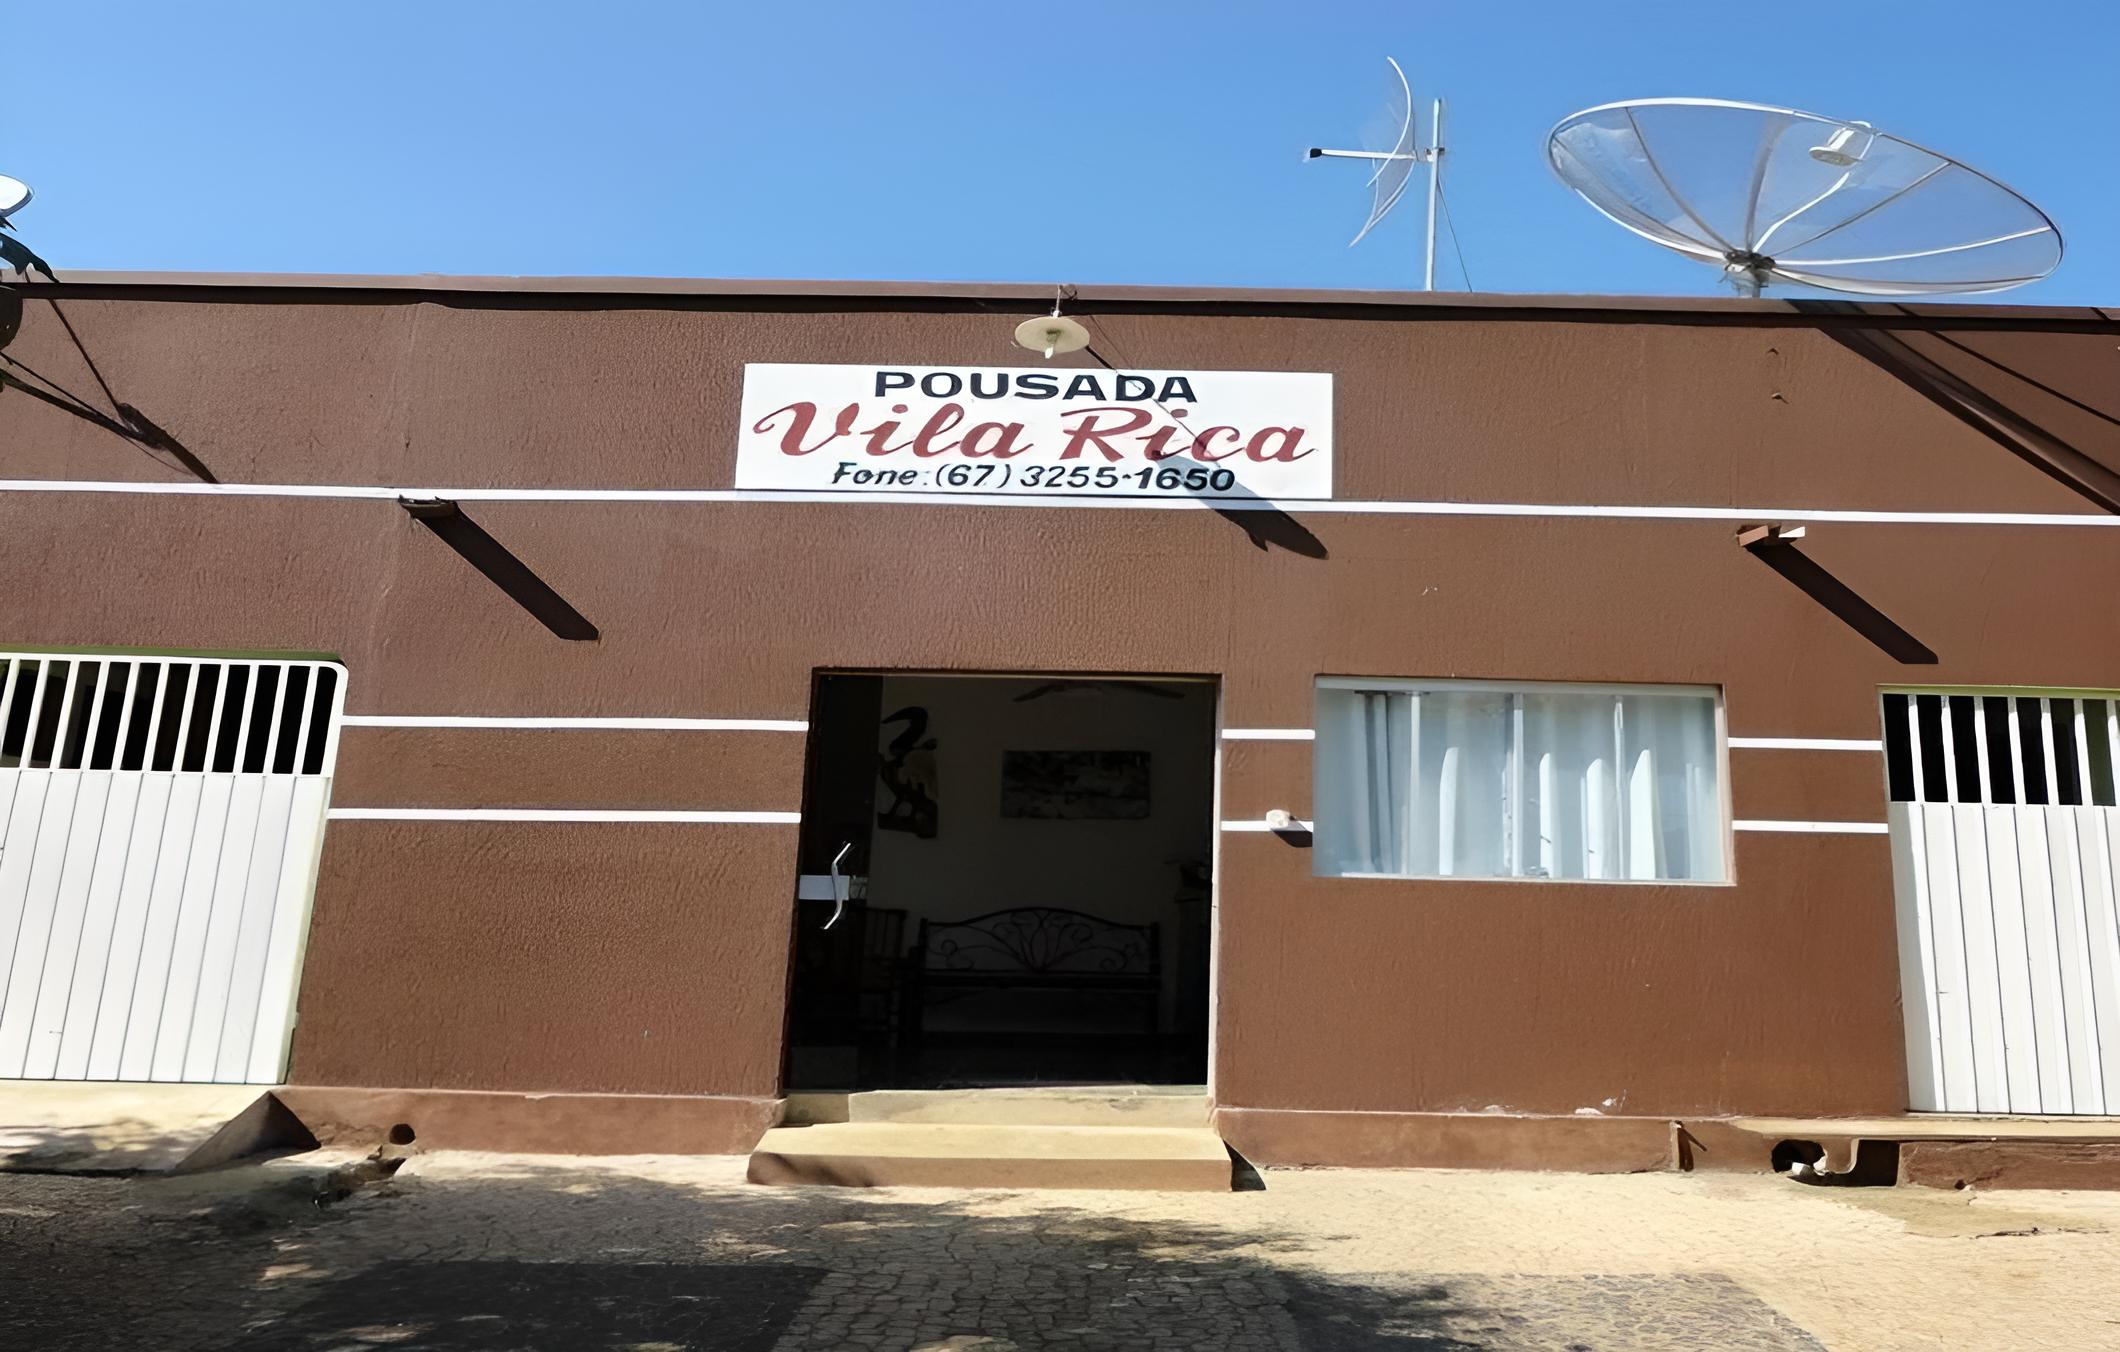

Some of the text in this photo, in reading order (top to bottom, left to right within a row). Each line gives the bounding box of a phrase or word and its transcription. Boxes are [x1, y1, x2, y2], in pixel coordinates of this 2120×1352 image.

[874, 371, 1198, 403] POUSADA
[753, 401, 1318, 464] Vila Rica
[1020, 466, 1235, 491] 3255-1650
